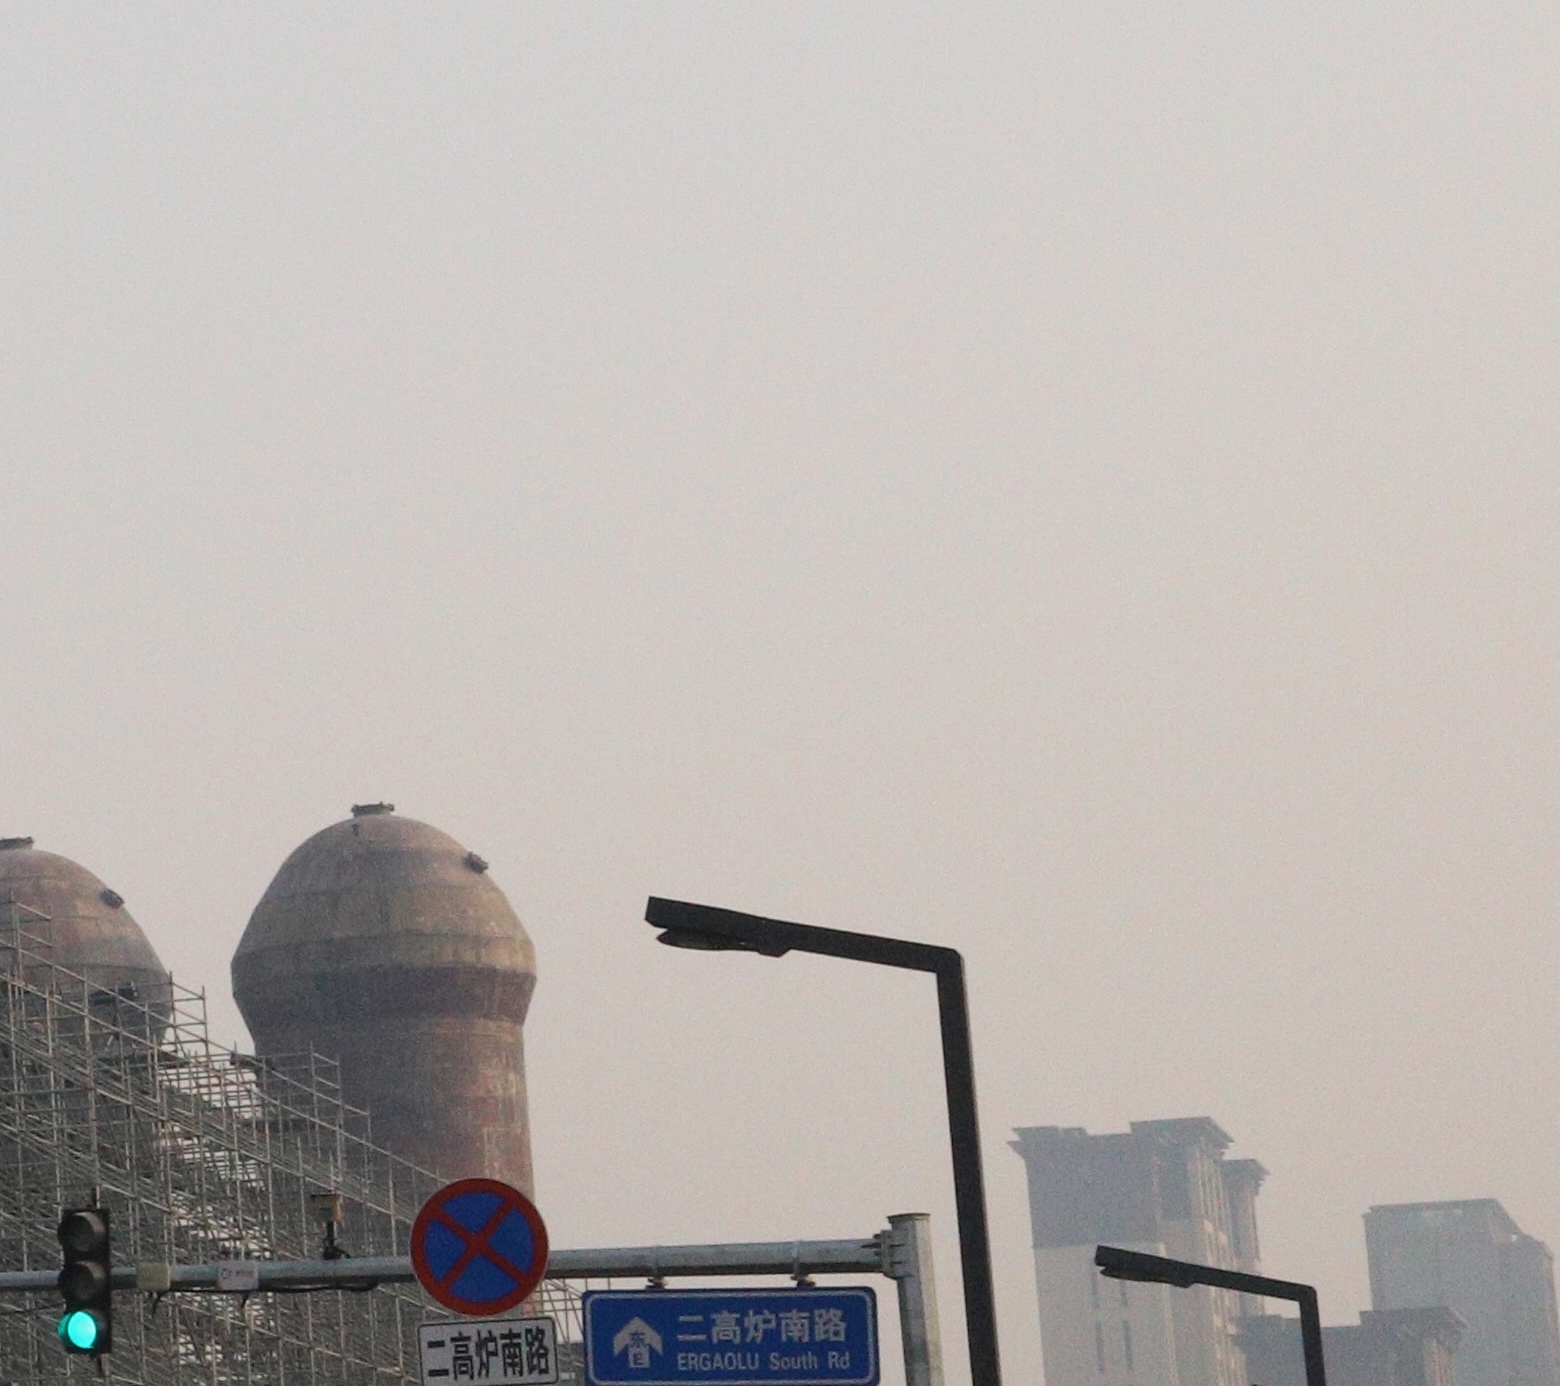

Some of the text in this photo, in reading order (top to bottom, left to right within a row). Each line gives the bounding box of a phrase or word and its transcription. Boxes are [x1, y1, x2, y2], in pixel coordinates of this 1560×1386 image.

[677, 1308, 848, 1345] 二高炉南路
[426, 1326, 552, 1382] 二高炉南路
[677, 1350, 851, 1372] ERGAOLU South Rd
